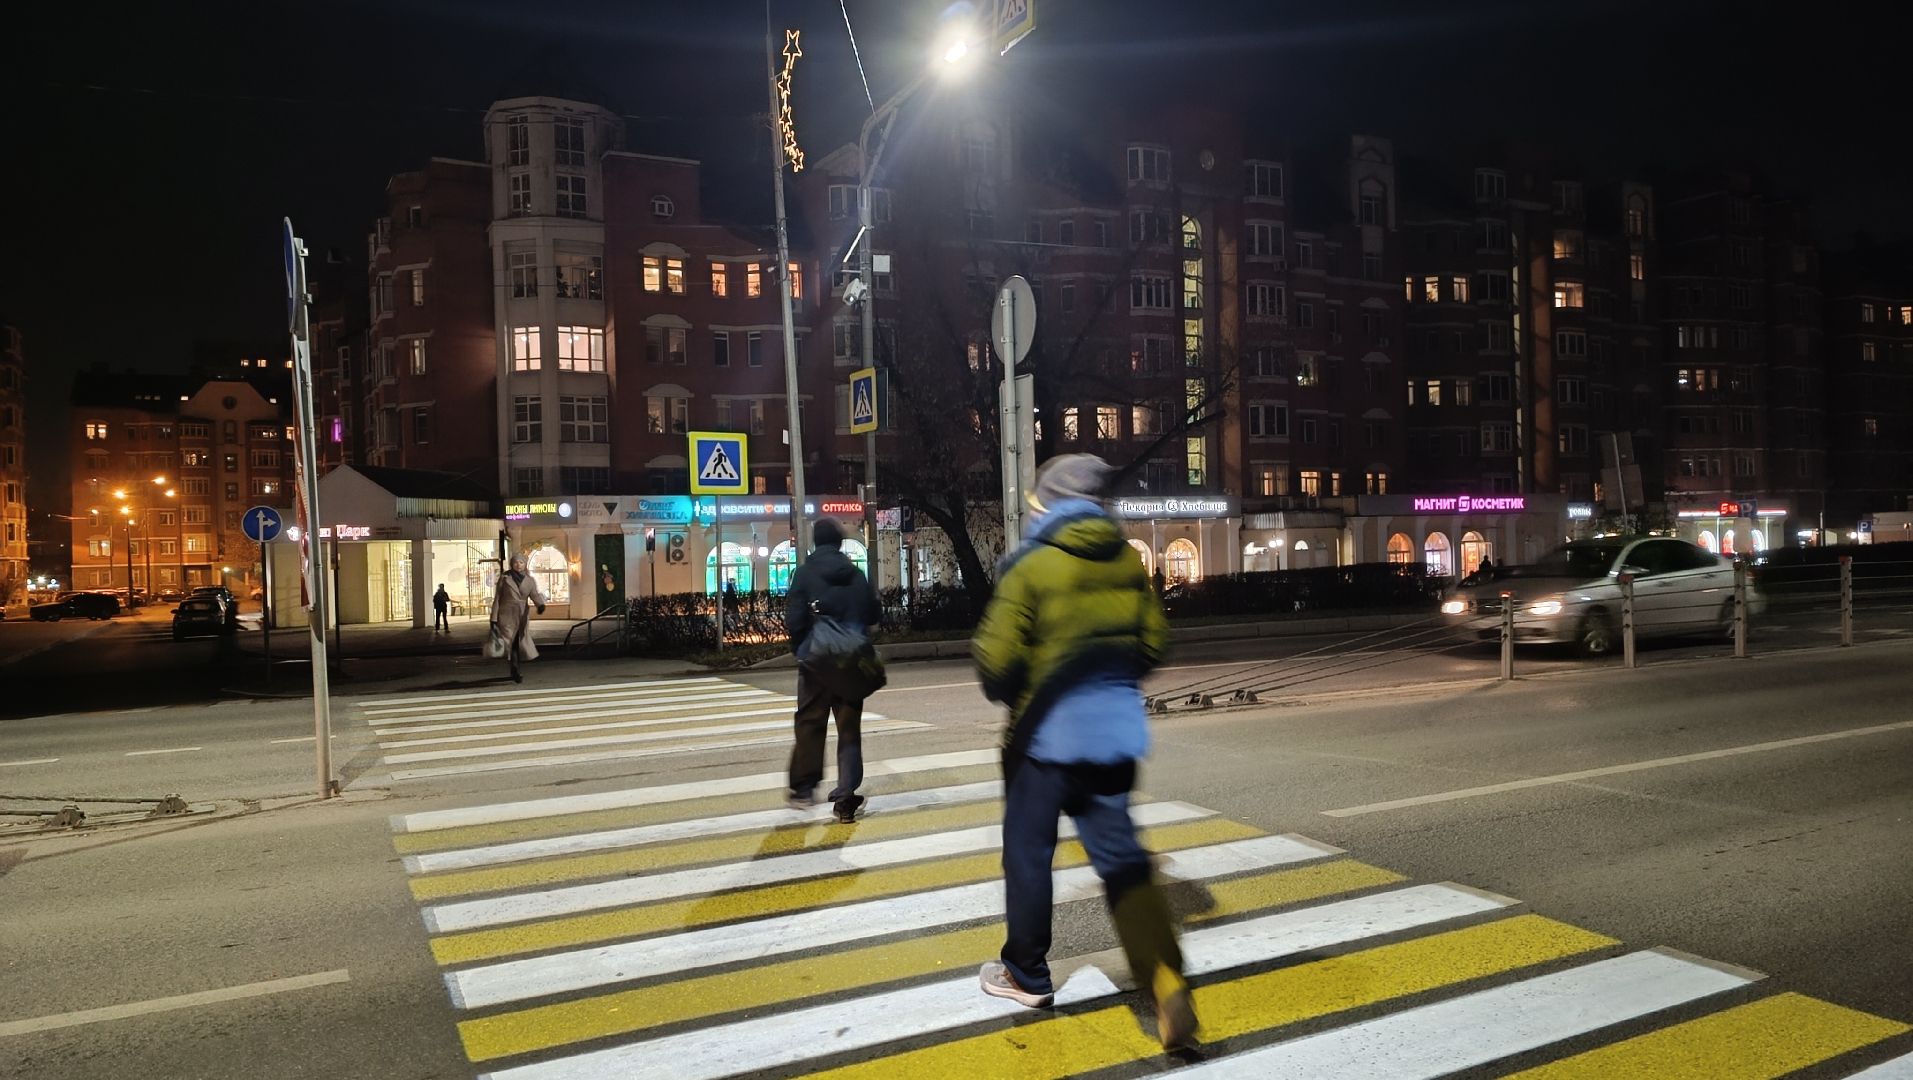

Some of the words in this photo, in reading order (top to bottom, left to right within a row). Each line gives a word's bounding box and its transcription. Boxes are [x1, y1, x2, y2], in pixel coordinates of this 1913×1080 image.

[1414, 498, 1456, 510] МАГНИТ
[1471, 498, 1525, 510] КОСМЕТИК
[1860, 522, 1869, 532] P
